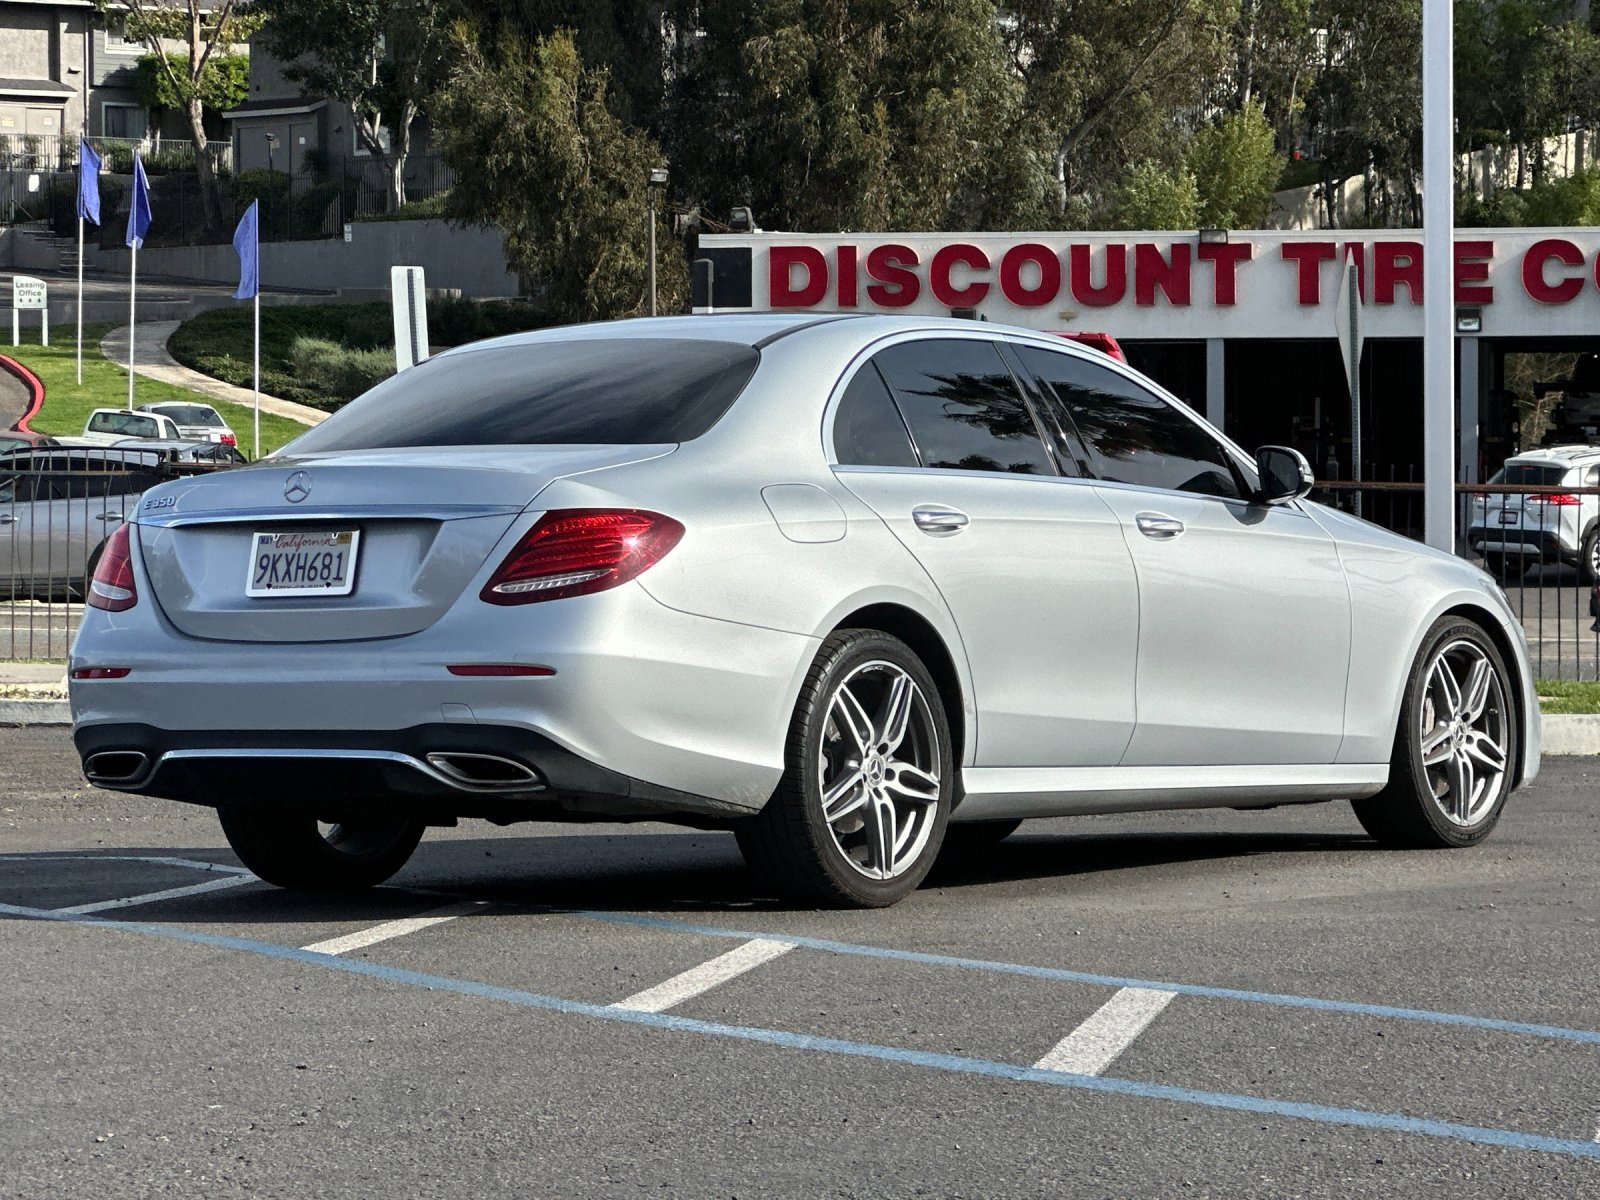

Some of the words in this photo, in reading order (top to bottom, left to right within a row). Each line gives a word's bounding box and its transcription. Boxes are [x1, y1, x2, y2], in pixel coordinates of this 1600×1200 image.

[768, 243, 1252, 308] DISCOUNT
[1521, 239, 1600, 305] C
[144, 496, 176, 510] E350
[275, 533, 336, 552] California
[255, 552, 343, 583] 9KXH681
